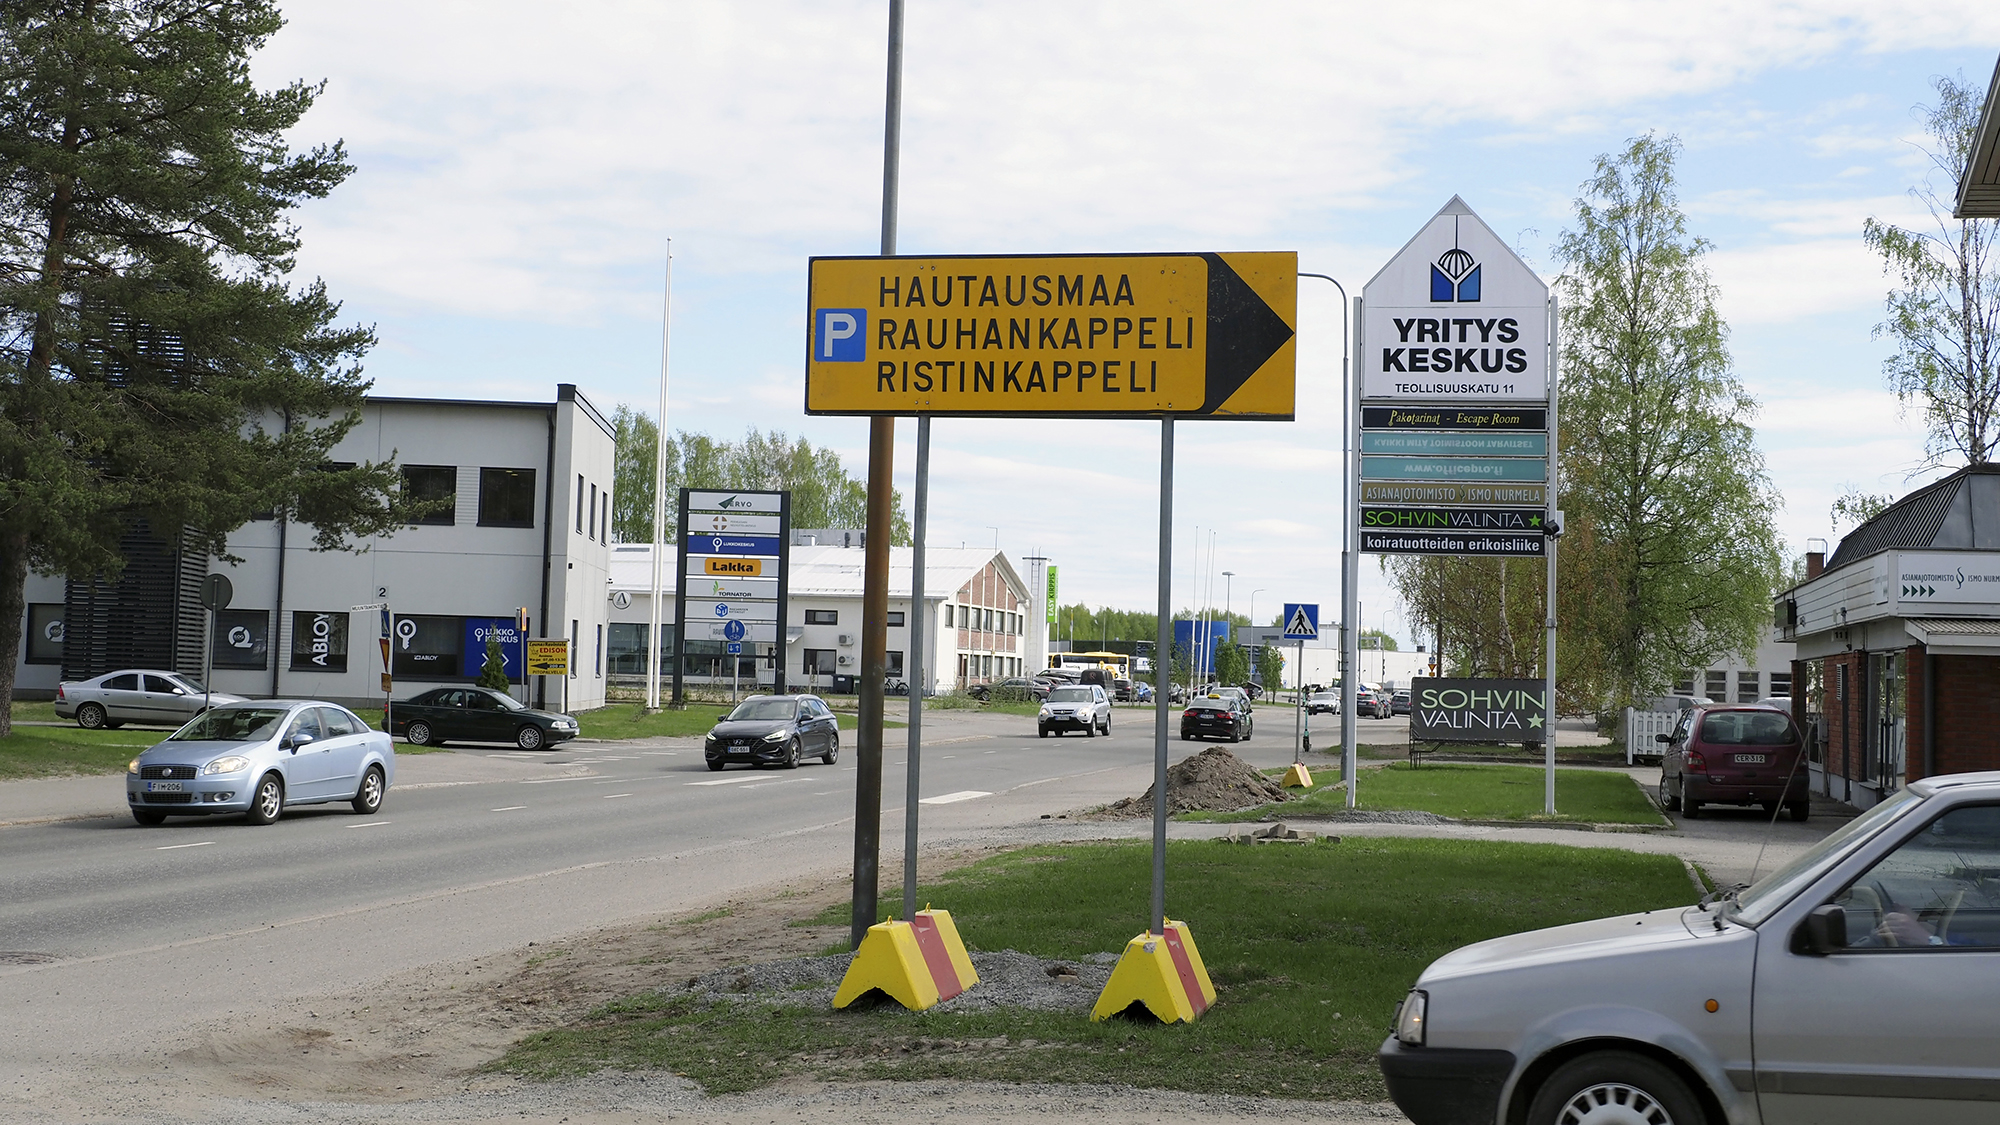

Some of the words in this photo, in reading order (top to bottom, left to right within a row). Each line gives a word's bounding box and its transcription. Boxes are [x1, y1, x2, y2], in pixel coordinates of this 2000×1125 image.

[879, 274, 1135, 308] HAUTAUSMAA
[823, 313, 857, 358] P
[878, 316, 1194, 350] RAUHANKAPPELI
[1392, 317, 1519, 343] YRITYS
[1382, 347, 1528, 374] KESKUS
[877, 360, 1158, 393] RISTINKAPPELI
[1395, 383, 1499, 394] TEOLLISUUSKATU
[1502, 384, 1514, 394] 11
[1388, 409, 1441, 427] Pakotarinat
[1456, 412, 1489, 426] Escape
[1491, 412, 1520, 426] Room
[1366, 487, 1456, 502] ASIANAJOTOIMISTO
[1468, 488, 1491, 501] ISMO
[1495, 489, 1541, 502] NURMELA
[1367, 536, 1464, 550] koiratuotteiden
[1468, 538, 1540, 552] erikoisliike
[712, 562, 754, 573] Lakka
[379, 587, 386, 597] 2
[1048, 572, 1056, 599] KIRPPIS
[1047, 599, 1055, 617] EASY
[312, 613, 330, 666] ABLOY
[485, 628, 514, 636] LUKKO
[1420, 689, 1546, 710] SOHVIN
[1420, 710, 1522, 729] VALINTA
